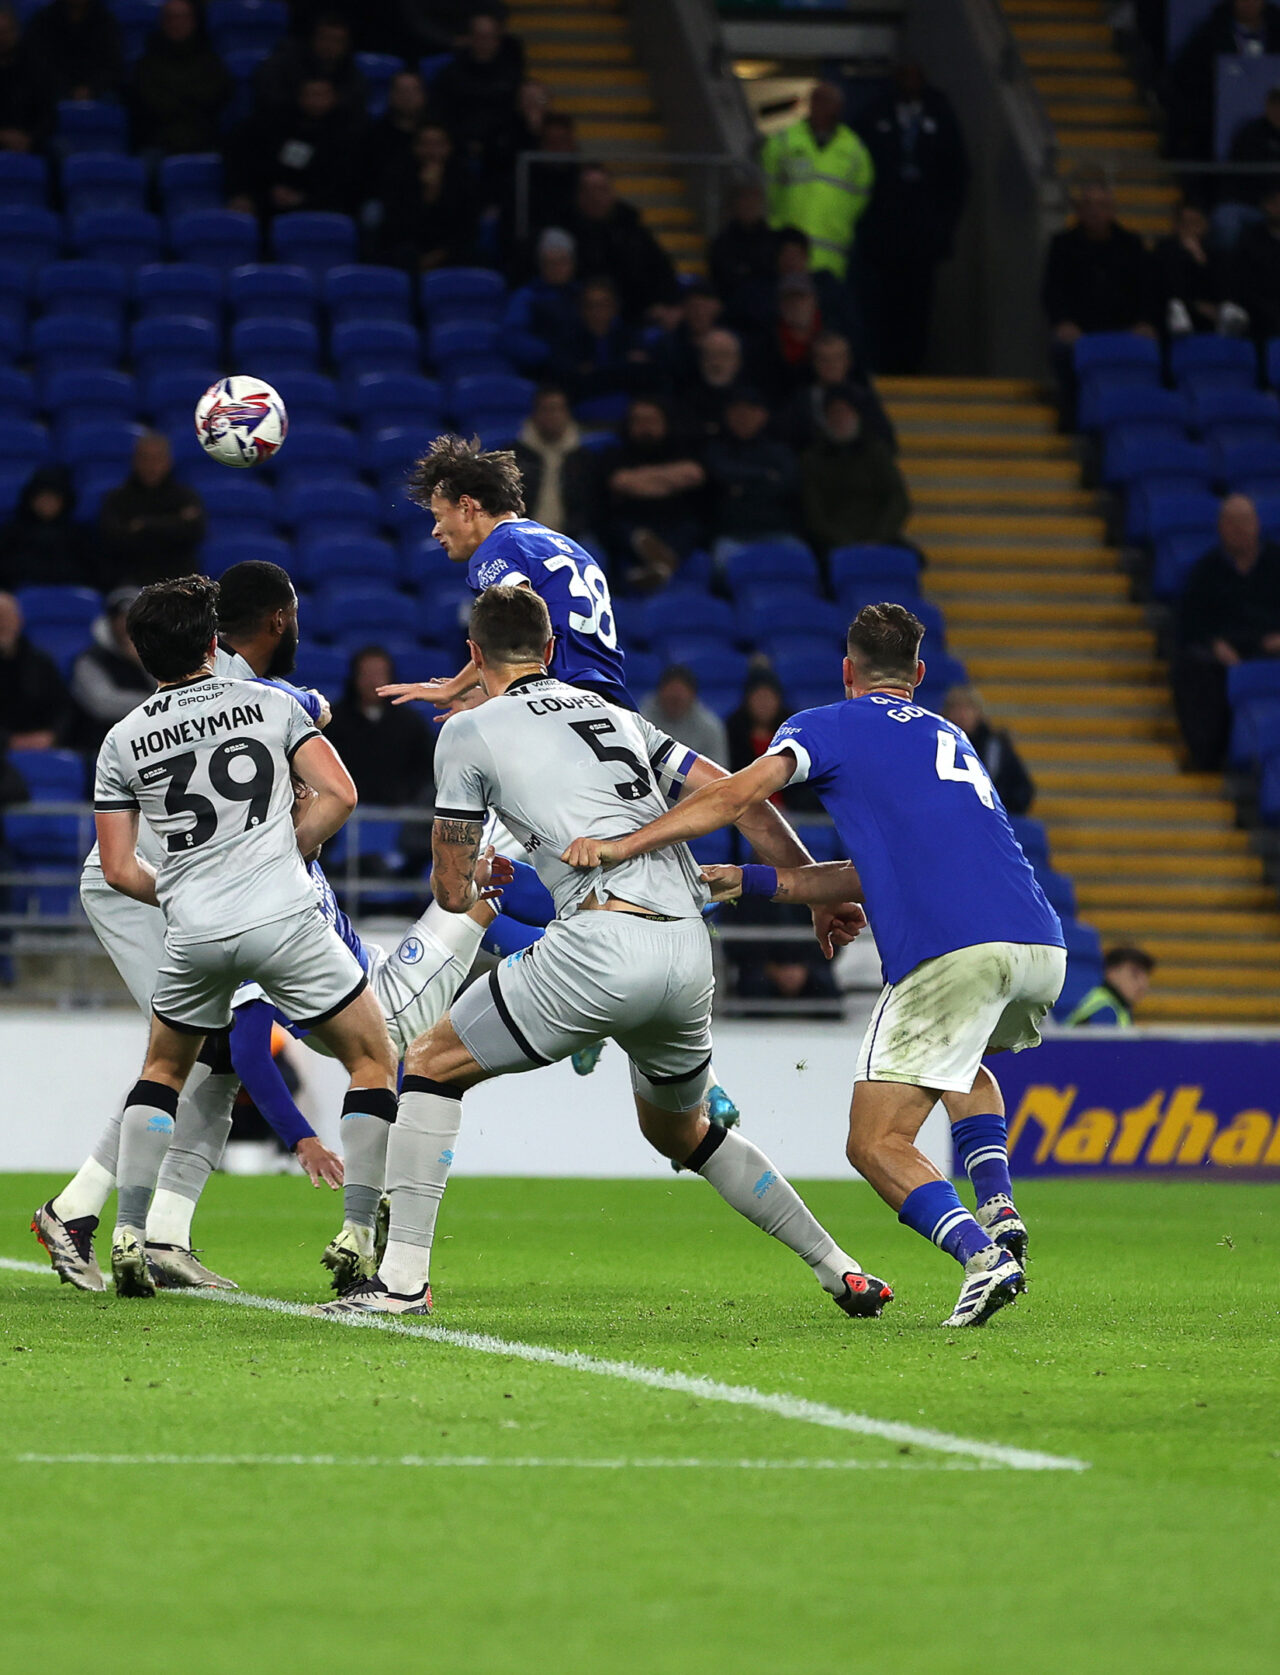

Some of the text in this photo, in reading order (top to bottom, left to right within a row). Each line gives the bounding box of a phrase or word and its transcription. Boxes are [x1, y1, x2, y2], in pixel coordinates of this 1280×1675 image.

[542, 554, 618, 650] 38
[130, 703, 265, 761] HONEYMAN
[177, 690, 224, 707] GROUP
[137, 736, 275, 853] 39
[567, 717, 653, 800] 5
[935, 729, 996, 810] 4
